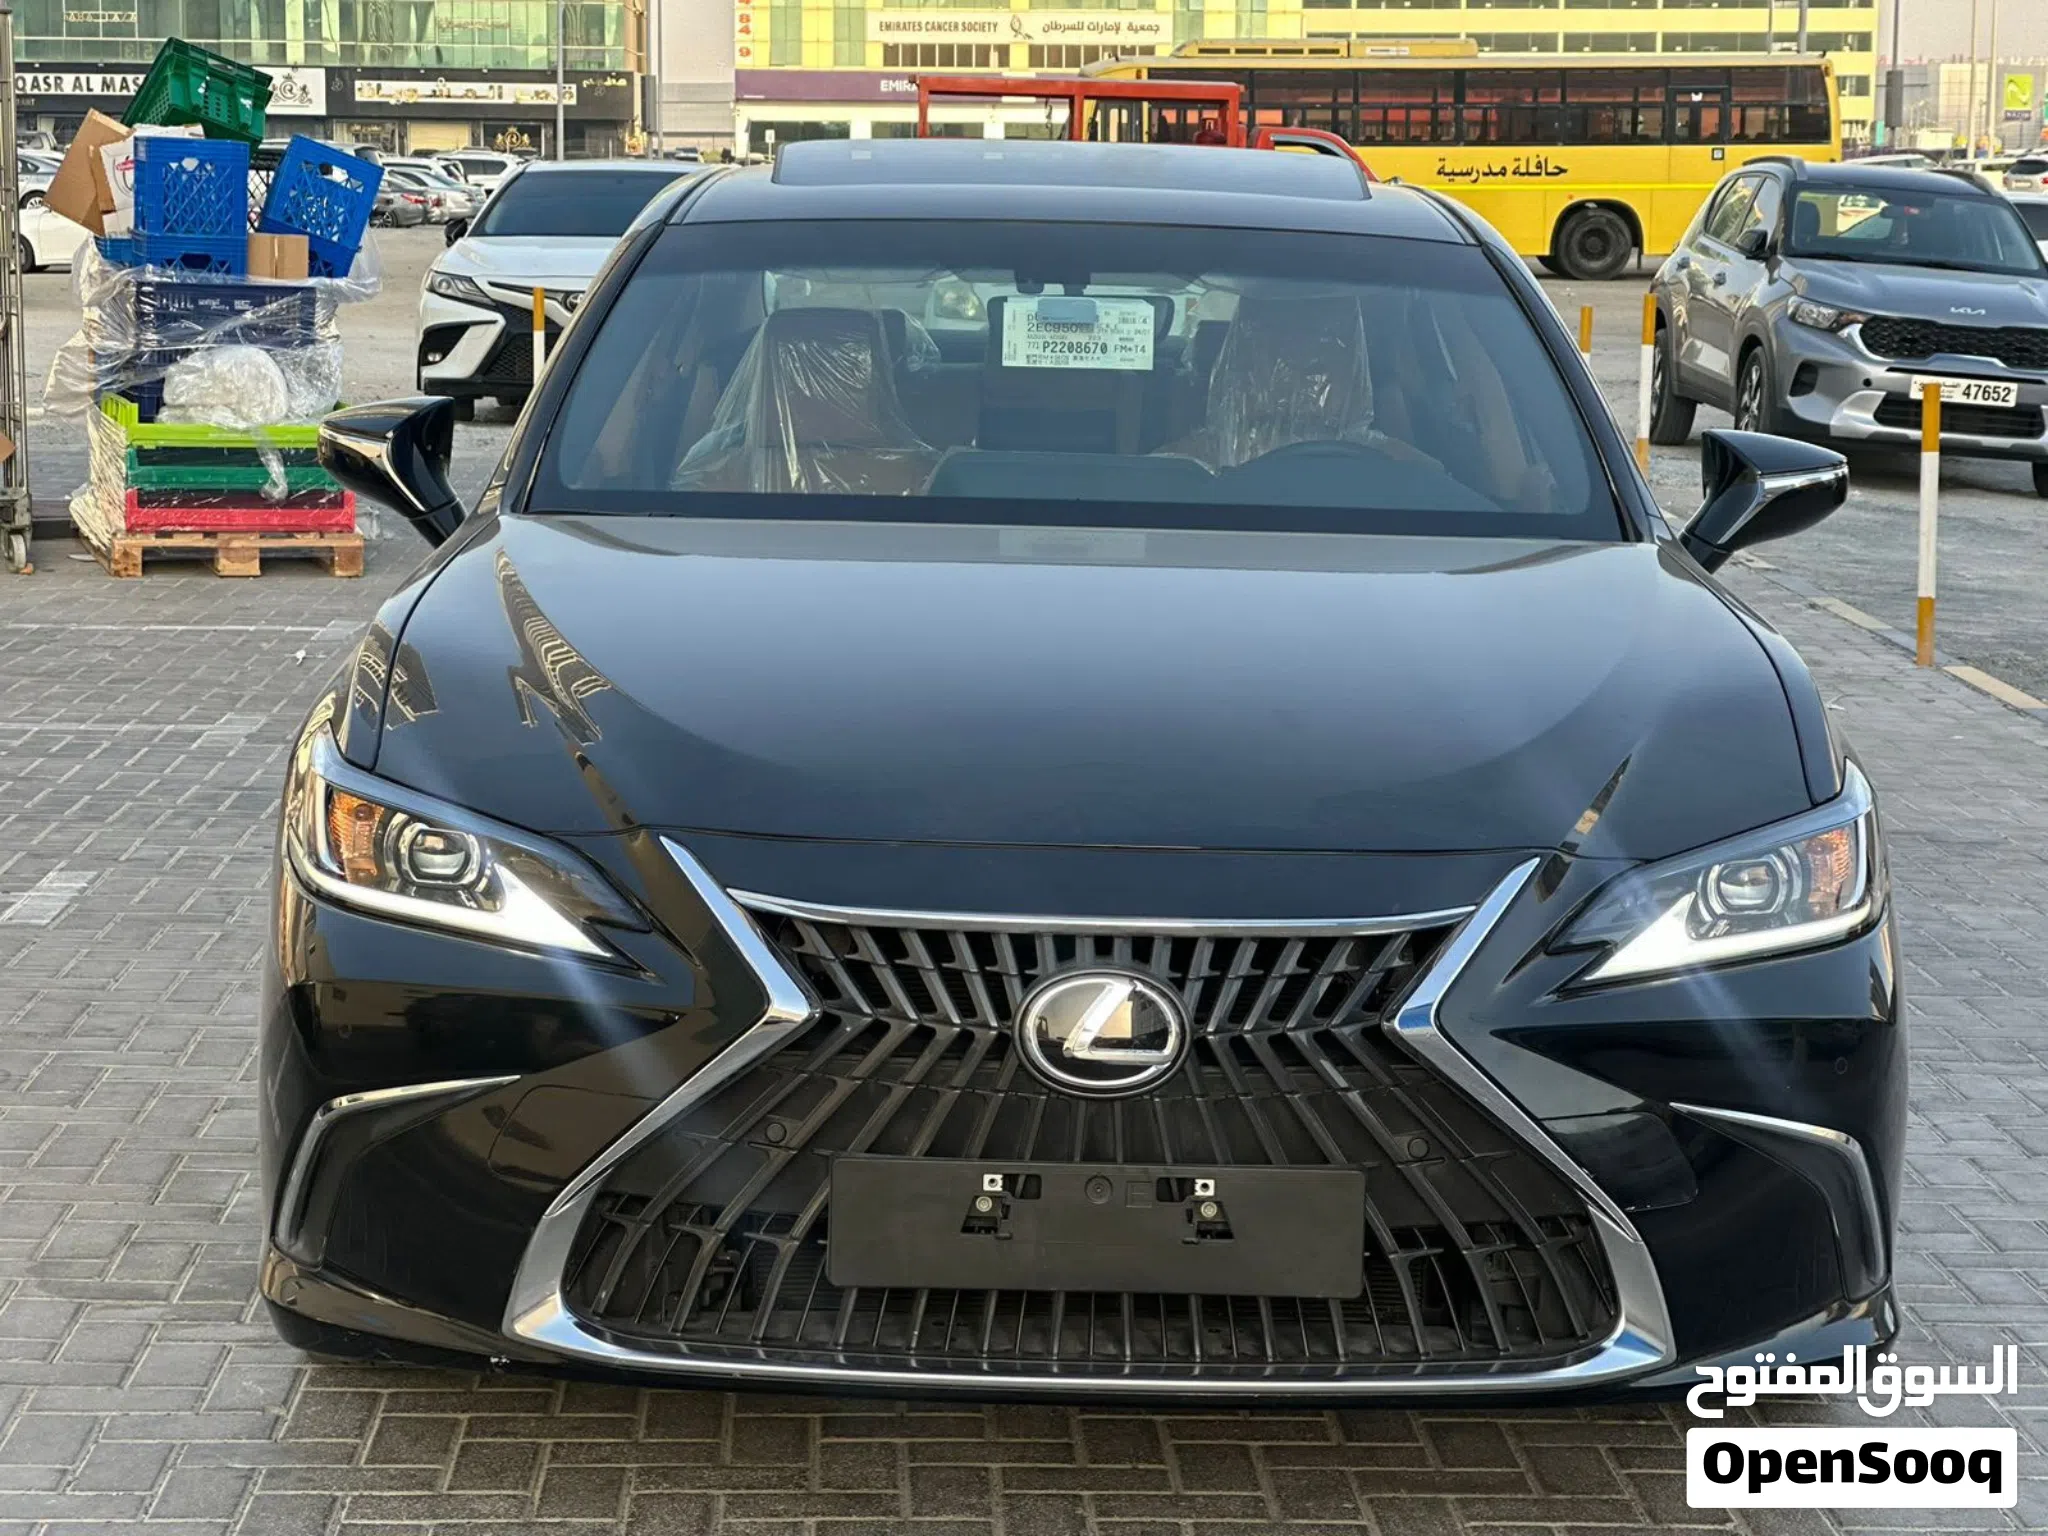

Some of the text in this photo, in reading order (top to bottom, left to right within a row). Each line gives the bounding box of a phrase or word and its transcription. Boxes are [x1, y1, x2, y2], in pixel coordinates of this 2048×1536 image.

[879, 20, 999, 33] EMIRATES CANCER SOCIETY
[1042, 20, 1084, 33] للسرطان
[1126, 21, 1160, 33] جمعية
[15, 75, 65, 94] QASR
[72, 75, 95, 93] AL
[1436, 154, 1569, 184] حافلة مدرسية
[1042, 341, 1108, 355] P2208670
[1961, 383, 2012, 403] 47652
